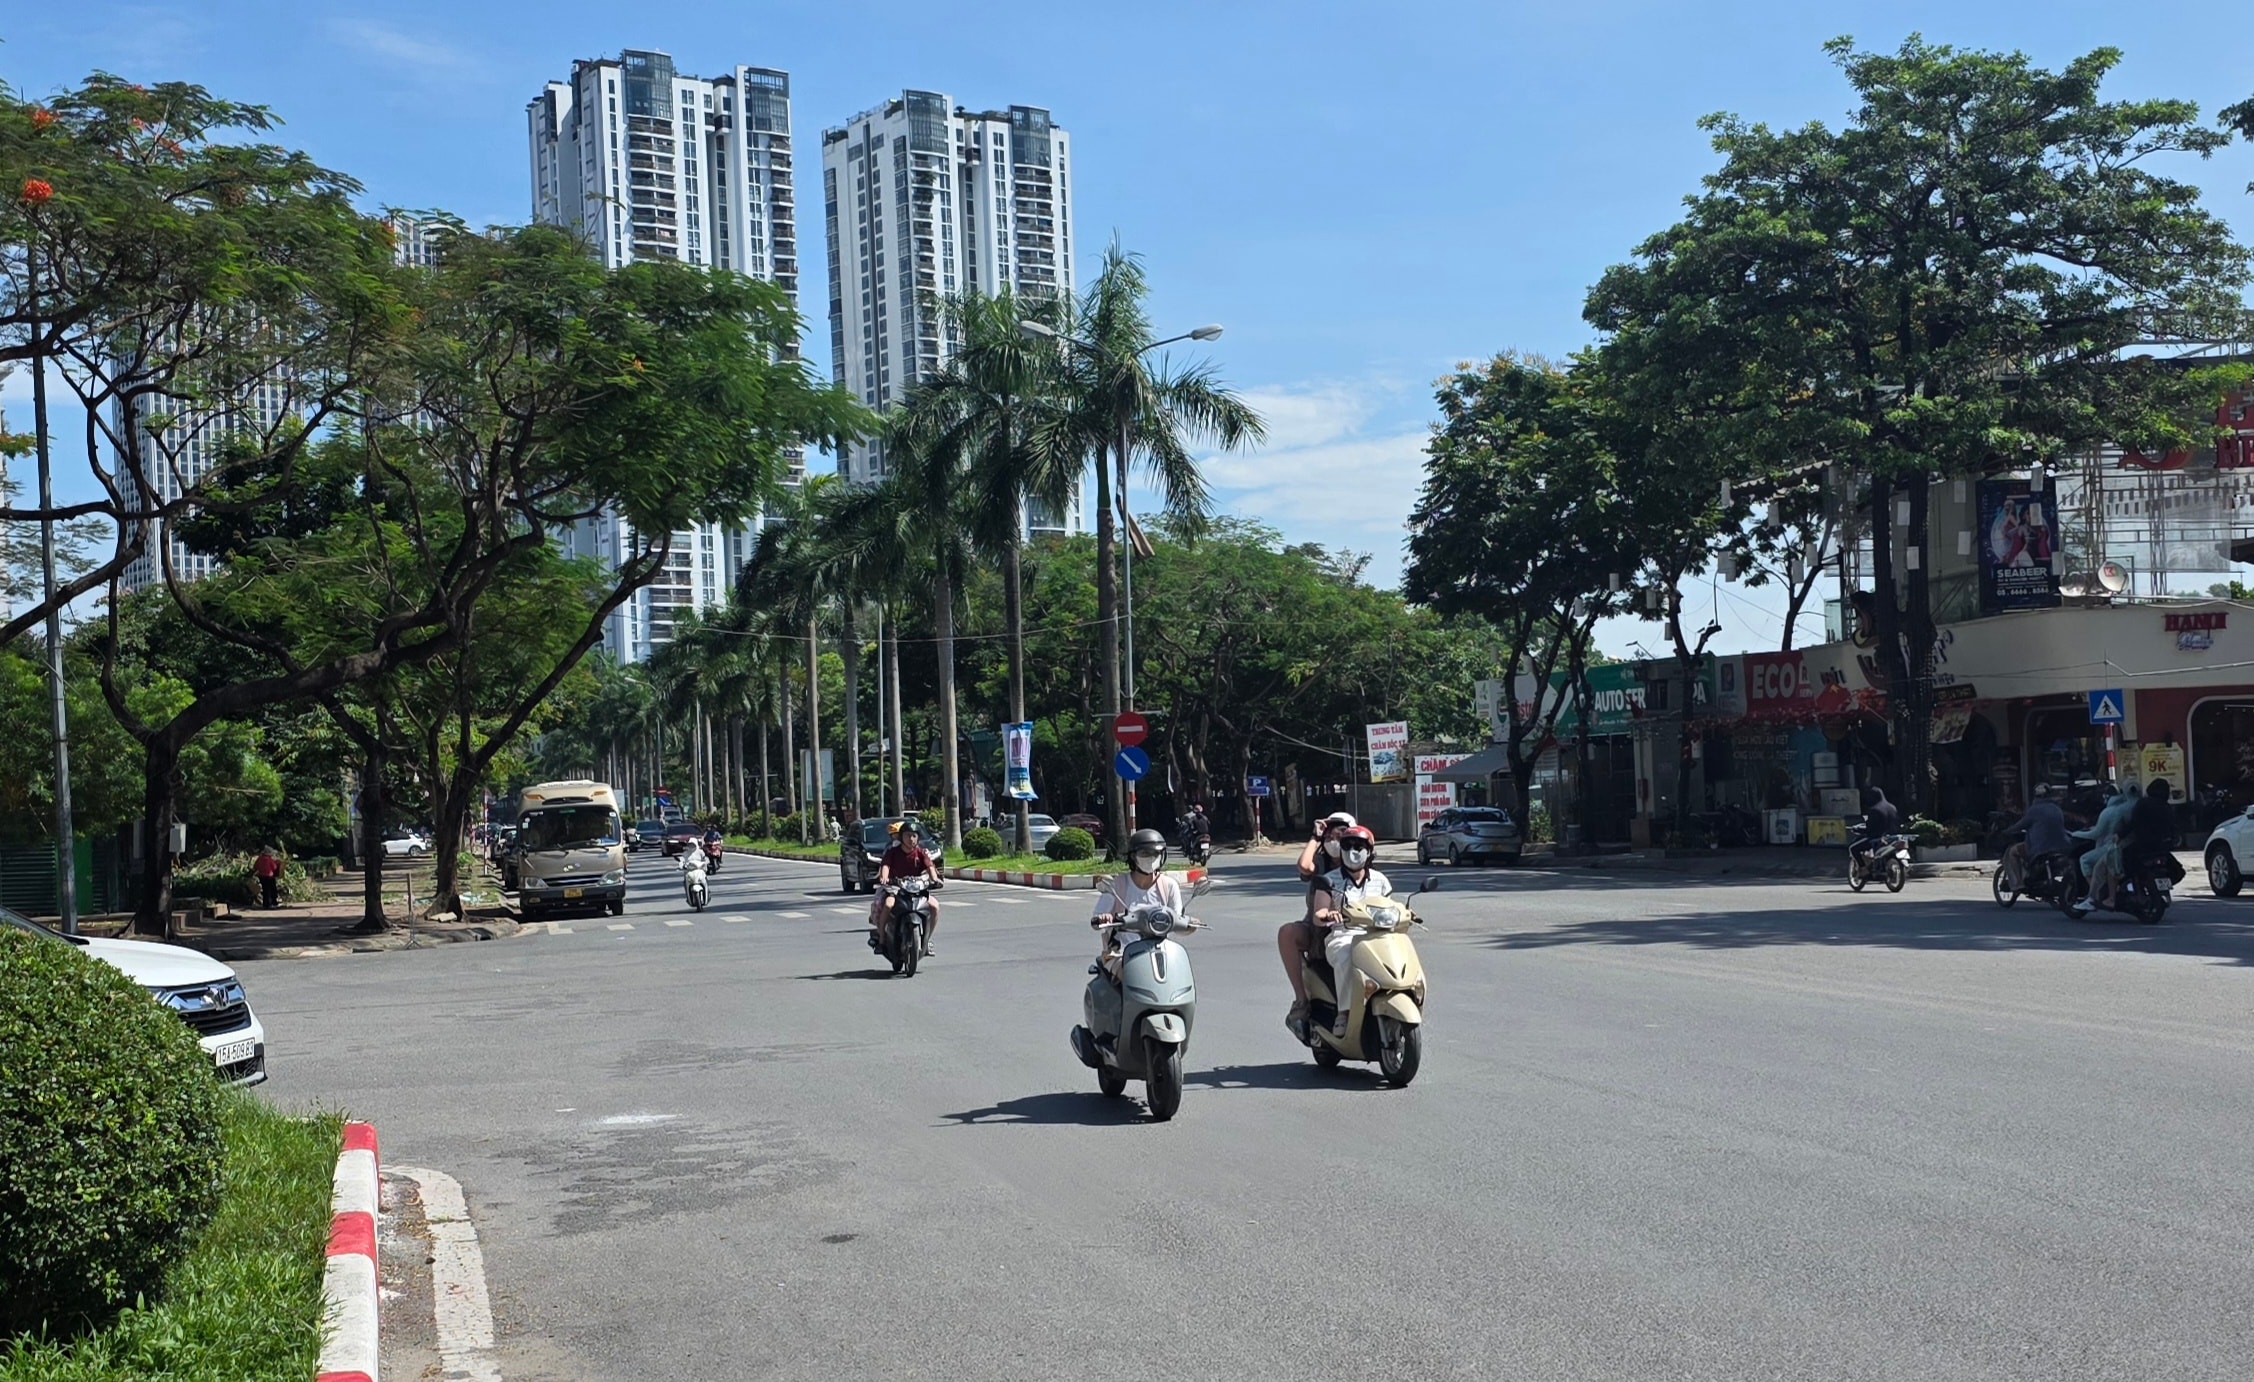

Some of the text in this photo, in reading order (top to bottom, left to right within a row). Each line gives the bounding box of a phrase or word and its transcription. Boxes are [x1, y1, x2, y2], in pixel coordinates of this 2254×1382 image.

[1997, 567, 2048, 578] SEABEER
[1752, 662, 1797, 700] ECO
[1594, 688, 1624, 713] AUTO
[2148, 760, 2167, 773] 9K
[1252, 778, 1262, 787] P
